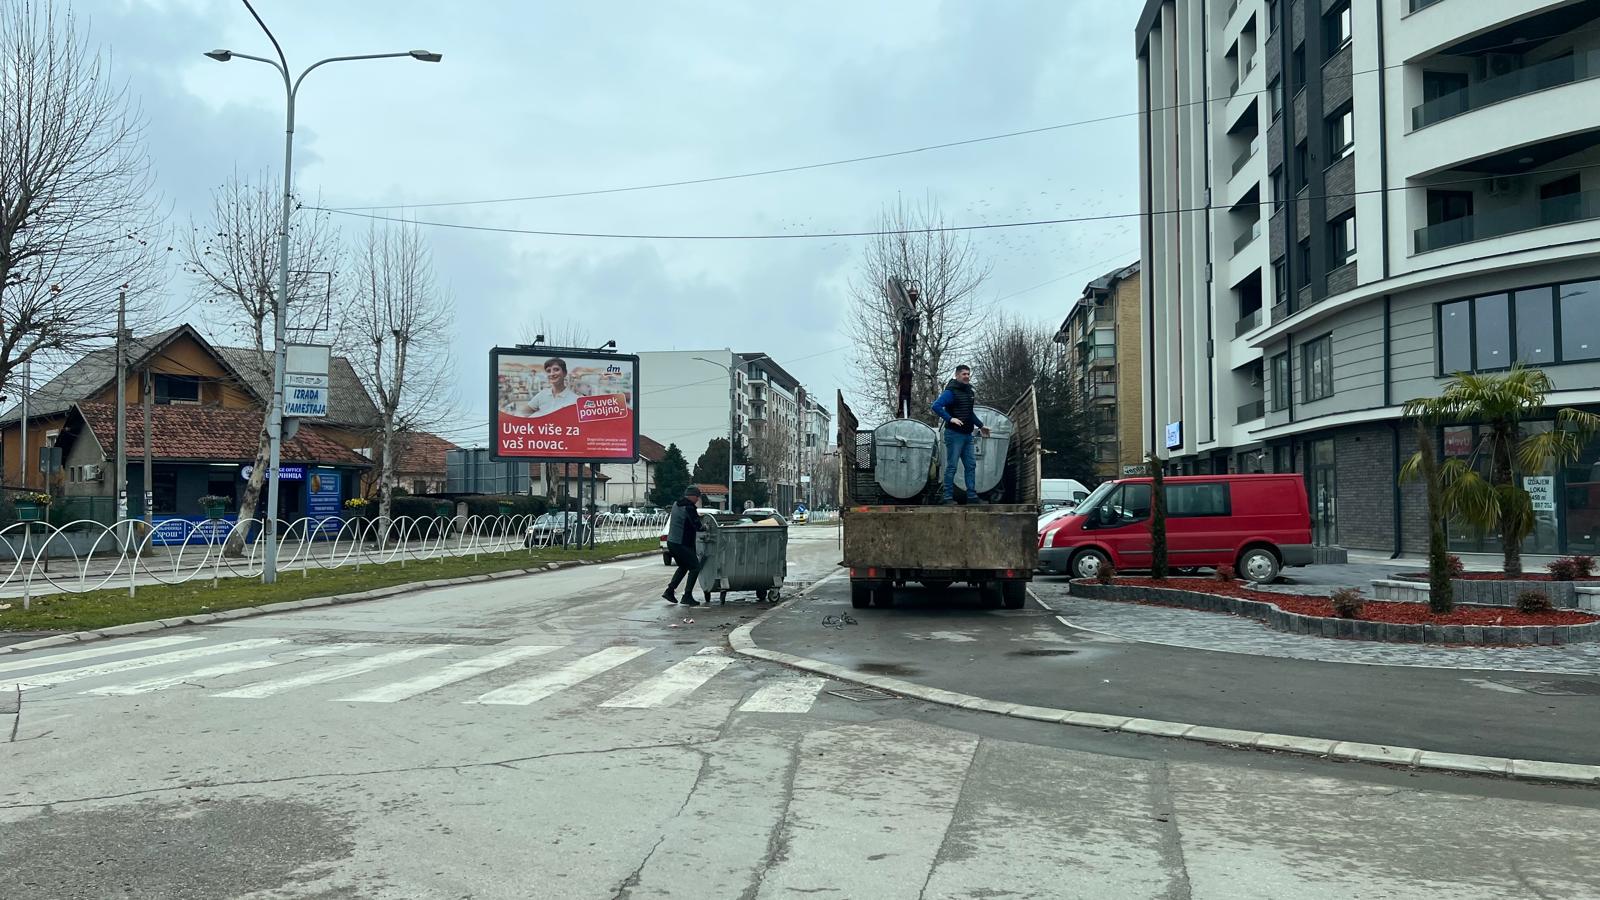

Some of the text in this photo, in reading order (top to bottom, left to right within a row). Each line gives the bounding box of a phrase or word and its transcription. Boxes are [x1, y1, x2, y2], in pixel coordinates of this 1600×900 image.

[606, 364, 621, 373] dm
[293, 389, 319, 400] IZRADA
[596, 397, 619, 407] uvek
[503, 422, 580, 436] Uvek više za
[502, 436, 568, 450] vaš novac.
